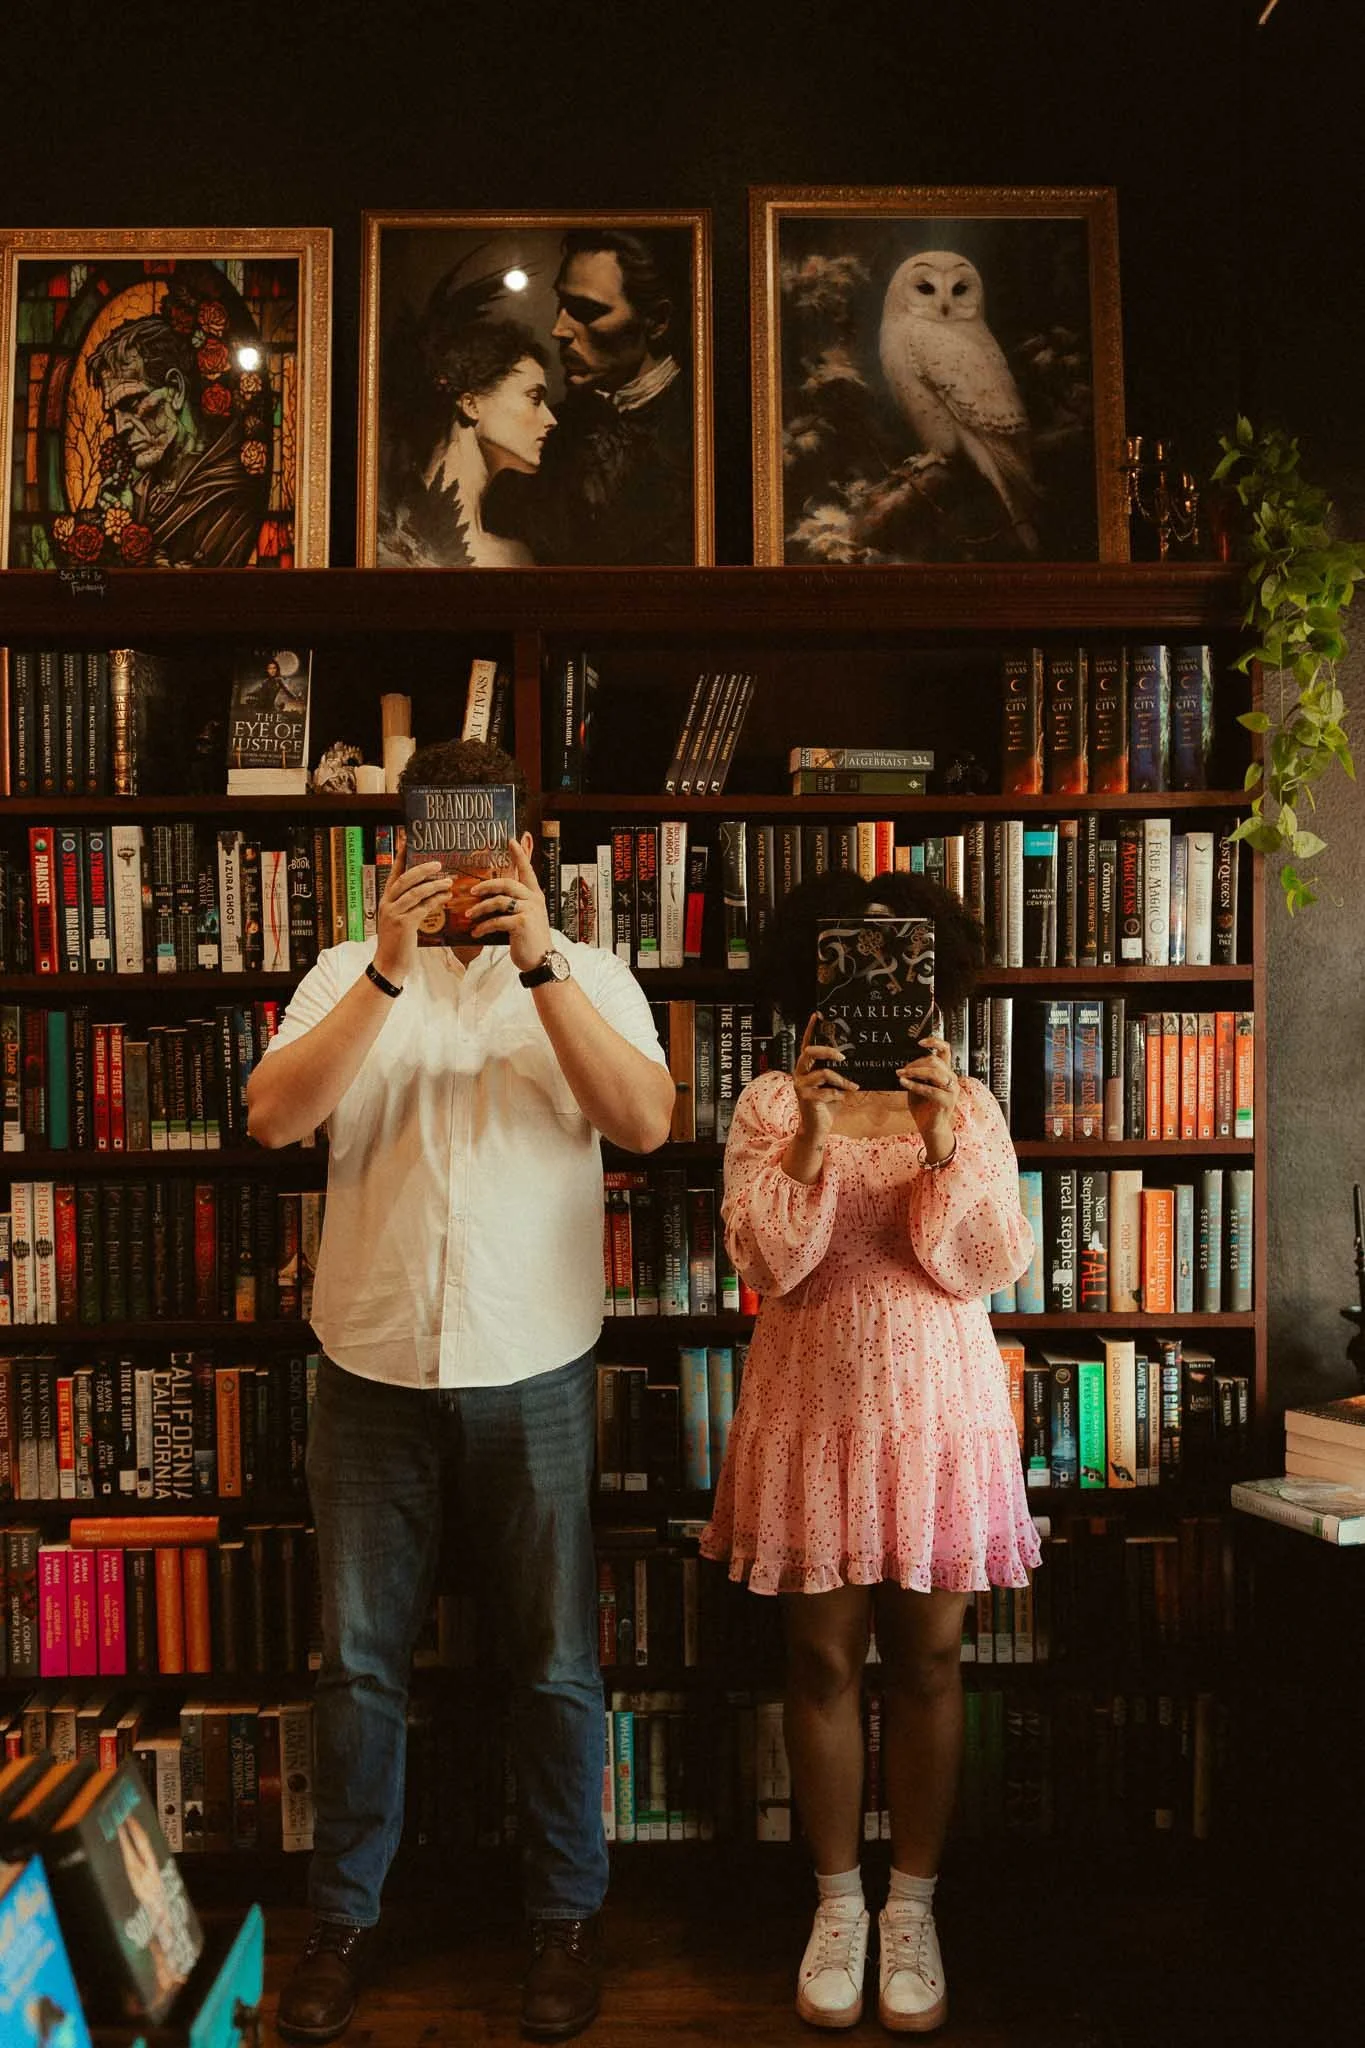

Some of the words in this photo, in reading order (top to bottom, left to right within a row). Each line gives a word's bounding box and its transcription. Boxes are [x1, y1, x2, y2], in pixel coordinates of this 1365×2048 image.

[473, 676, 488, 718] SMALL
[1005, 703, 1026, 712] CITY
[1052, 703, 1072, 712] CITY
[1095, 702, 1116, 711] CITY
[1134, 701, 1154, 710] CITY
[1175, 700, 1197, 709] CITY
[18, 706, 26, 728] BLACK
[42, 705, 51, 728] BLACK
[65, 705, 73, 728] BLACK
[235, 720, 271, 738] EYE
[274, 722, 303, 740] OF
[256, 712, 283, 722] THE
[564, 717, 572, 746] DISARRAY
[42, 746, 51, 773] ORACLE
[231, 738, 303, 754] JUSTICE
[18, 747, 26, 776] ORACLE
[65, 747, 73, 774] ORACLE
[848, 757, 908, 767] ALGEBRAIST
[426, 793, 494, 820] BRANDON
[411, 820, 508, 851] SANDERSON
[974, 827, 982, 856] NAOMI
[992, 826, 1000, 851] NAOMI
[1088, 817, 1096, 840] SMALL
[348, 832, 356, 877] CHARLAINE
[615, 834, 624, 880] MORGAN
[624, 833, 632, 870] RICHARD
[639, 833, 647, 880] MORGAN
[647, 833, 655, 871] RICHARD
[666, 827, 674, 865] MORGAN
[783, 834, 791, 856] KATE
[1065, 841, 1073, 863] SMALL
[1088, 843, 1096, 873] ANGELS
[1148, 841, 1161, 872] FREE
[224, 860, 235, 890] AZURA
[288, 857, 311, 871] BOOK
[783, 858, 791, 894] MORTON
[992, 852, 1000, 876] NOVIK
[1065, 864, 1073, 892] ANGELS
[35, 855, 50, 904] PARASITE
[62, 852, 78, 906] SYMBIONT
[90, 852, 105, 905] SYMBIONT
[120, 874, 136, 900] LADY
[290, 881, 312, 898] LIFE
[1101, 862, 1111, 913] COMPANY
[1121, 842, 1136, 915] MAGICIANS
[1218, 865, 1231, 908] QUEEN
[349, 879, 357, 909] HARRIS
[1149, 877, 1161, 916] MAGIC
[65, 908, 80, 928] MIRA
[92, 907, 106, 927] MIRA
[224, 894, 235, 925] GHOST
[64, 929, 80, 956] GRANT
[720, 1007, 733, 1030] THE
[740, 1016, 752, 1030] THE
[828, 1004, 925, 1018] STARLESS
[96, 1037, 104, 1062] TRUTH
[112, 1034, 120, 1065] RADIANT
[224, 1027, 232, 1069] EFFORT
[720, 1033, 733, 1069] SOLAR
[740, 1032, 752, 1051] LOST
[858, 1031, 893, 1044] SEA
[1052, 1027, 1066, 1047] THE
[1082, 1027, 1096, 1047] THE
[6, 1042, 19, 1075] Dune
[75, 1052, 84, 1086] LEGACY
[700, 1056, 709, 1087] ATLANTIS
[853, 1059, 905, 1067] MORGENST
[1052, 1050, 1066, 1069] WAY
[1082, 1050, 1096, 1069] WAY
[112, 1069, 121, 1094] STATE
[720, 1073, 732, 1098] WAR
[76, 1105, 84, 1134] KINGS
[194, 1101, 203, 1119] CITY
[1060, 1175, 1076, 1210] neal
[15, 1188, 25, 1236] RICHARD
[38, 1187, 49, 1235] RICHARD
[1080, 1176, 1094, 1242] Stephenson
[1095, 1196, 1106, 1222] Neal
[1157, 1199, 1169, 1228] neal
[1056, 1216, 1076, 1309] stepheson
[1153, 1231, 1169, 1306] stephenson
[16, 1264, 28, 1308] KADREY
[39, 1263, 50, 1308] KADREY
[1080, 1249, 1108, 1305] FALL
[1112, 1357, 1122, 1386] LORDS
[1165, 1351, 1176, 1366] THE
[22, 1373, 33, 1402] HOLY
[40, 1373, 49, 1402] HOLY
[120, 1370, 132, 1392] TRICK
[1137, 1362, 1146, 1386] LAVIE
[1163, 1368, 1178, 1392] GOD
[61, 1388, 70, 1403] THE
[96, 1380, 104, 1412] TOWER
[104, 1380, 112, 1412] RAVEN
[120, 1396, 132, 1406] OF
[1084, 1402, 1091, 1414] OF
[1113, 1388, 1122, 1402] OF
[1137, 1388, 1146, 1419] TIDHAR
[22, 1406, 33, 1439] SISTER
[40, 1406, 50, 1438] SISTER
[121, 1409, 132, 1431] LIGHT
[290, 1405, 304, 1432] LIU
[1164, 1394, 1178, 1428] GAME
[153, 1373, 172, 1500] CALIFORNIA
[171, 1352, 193, 1500] CALIFORNIA
[1113, 1404, 1122, 1462] UNCREATION
[106, 1444, 114, 1464] ANN
[10, 1544, 18, 1568] MAAS
[22, 1536, 30, 1564] SARAH
[44, 1562, 52, 1586] MAAS
[53, 1558, 61, 1584] SARAH
[72, 1561, 80, 1584] MAAS
[102, 1560, 110, 1584] MAAS
[111, 1556, 119, 1582] SARAH
[11, 1596, 20, 1628] SILVER
[112, 1608, 120, 1632] COURT
[12, 1628, 20, 1664] FLAMES
[22, 1625, 31, 1655] COURT
[869, 1714, 880, 1752] AMPED
[244, 1754, 255, 1790] STORM
